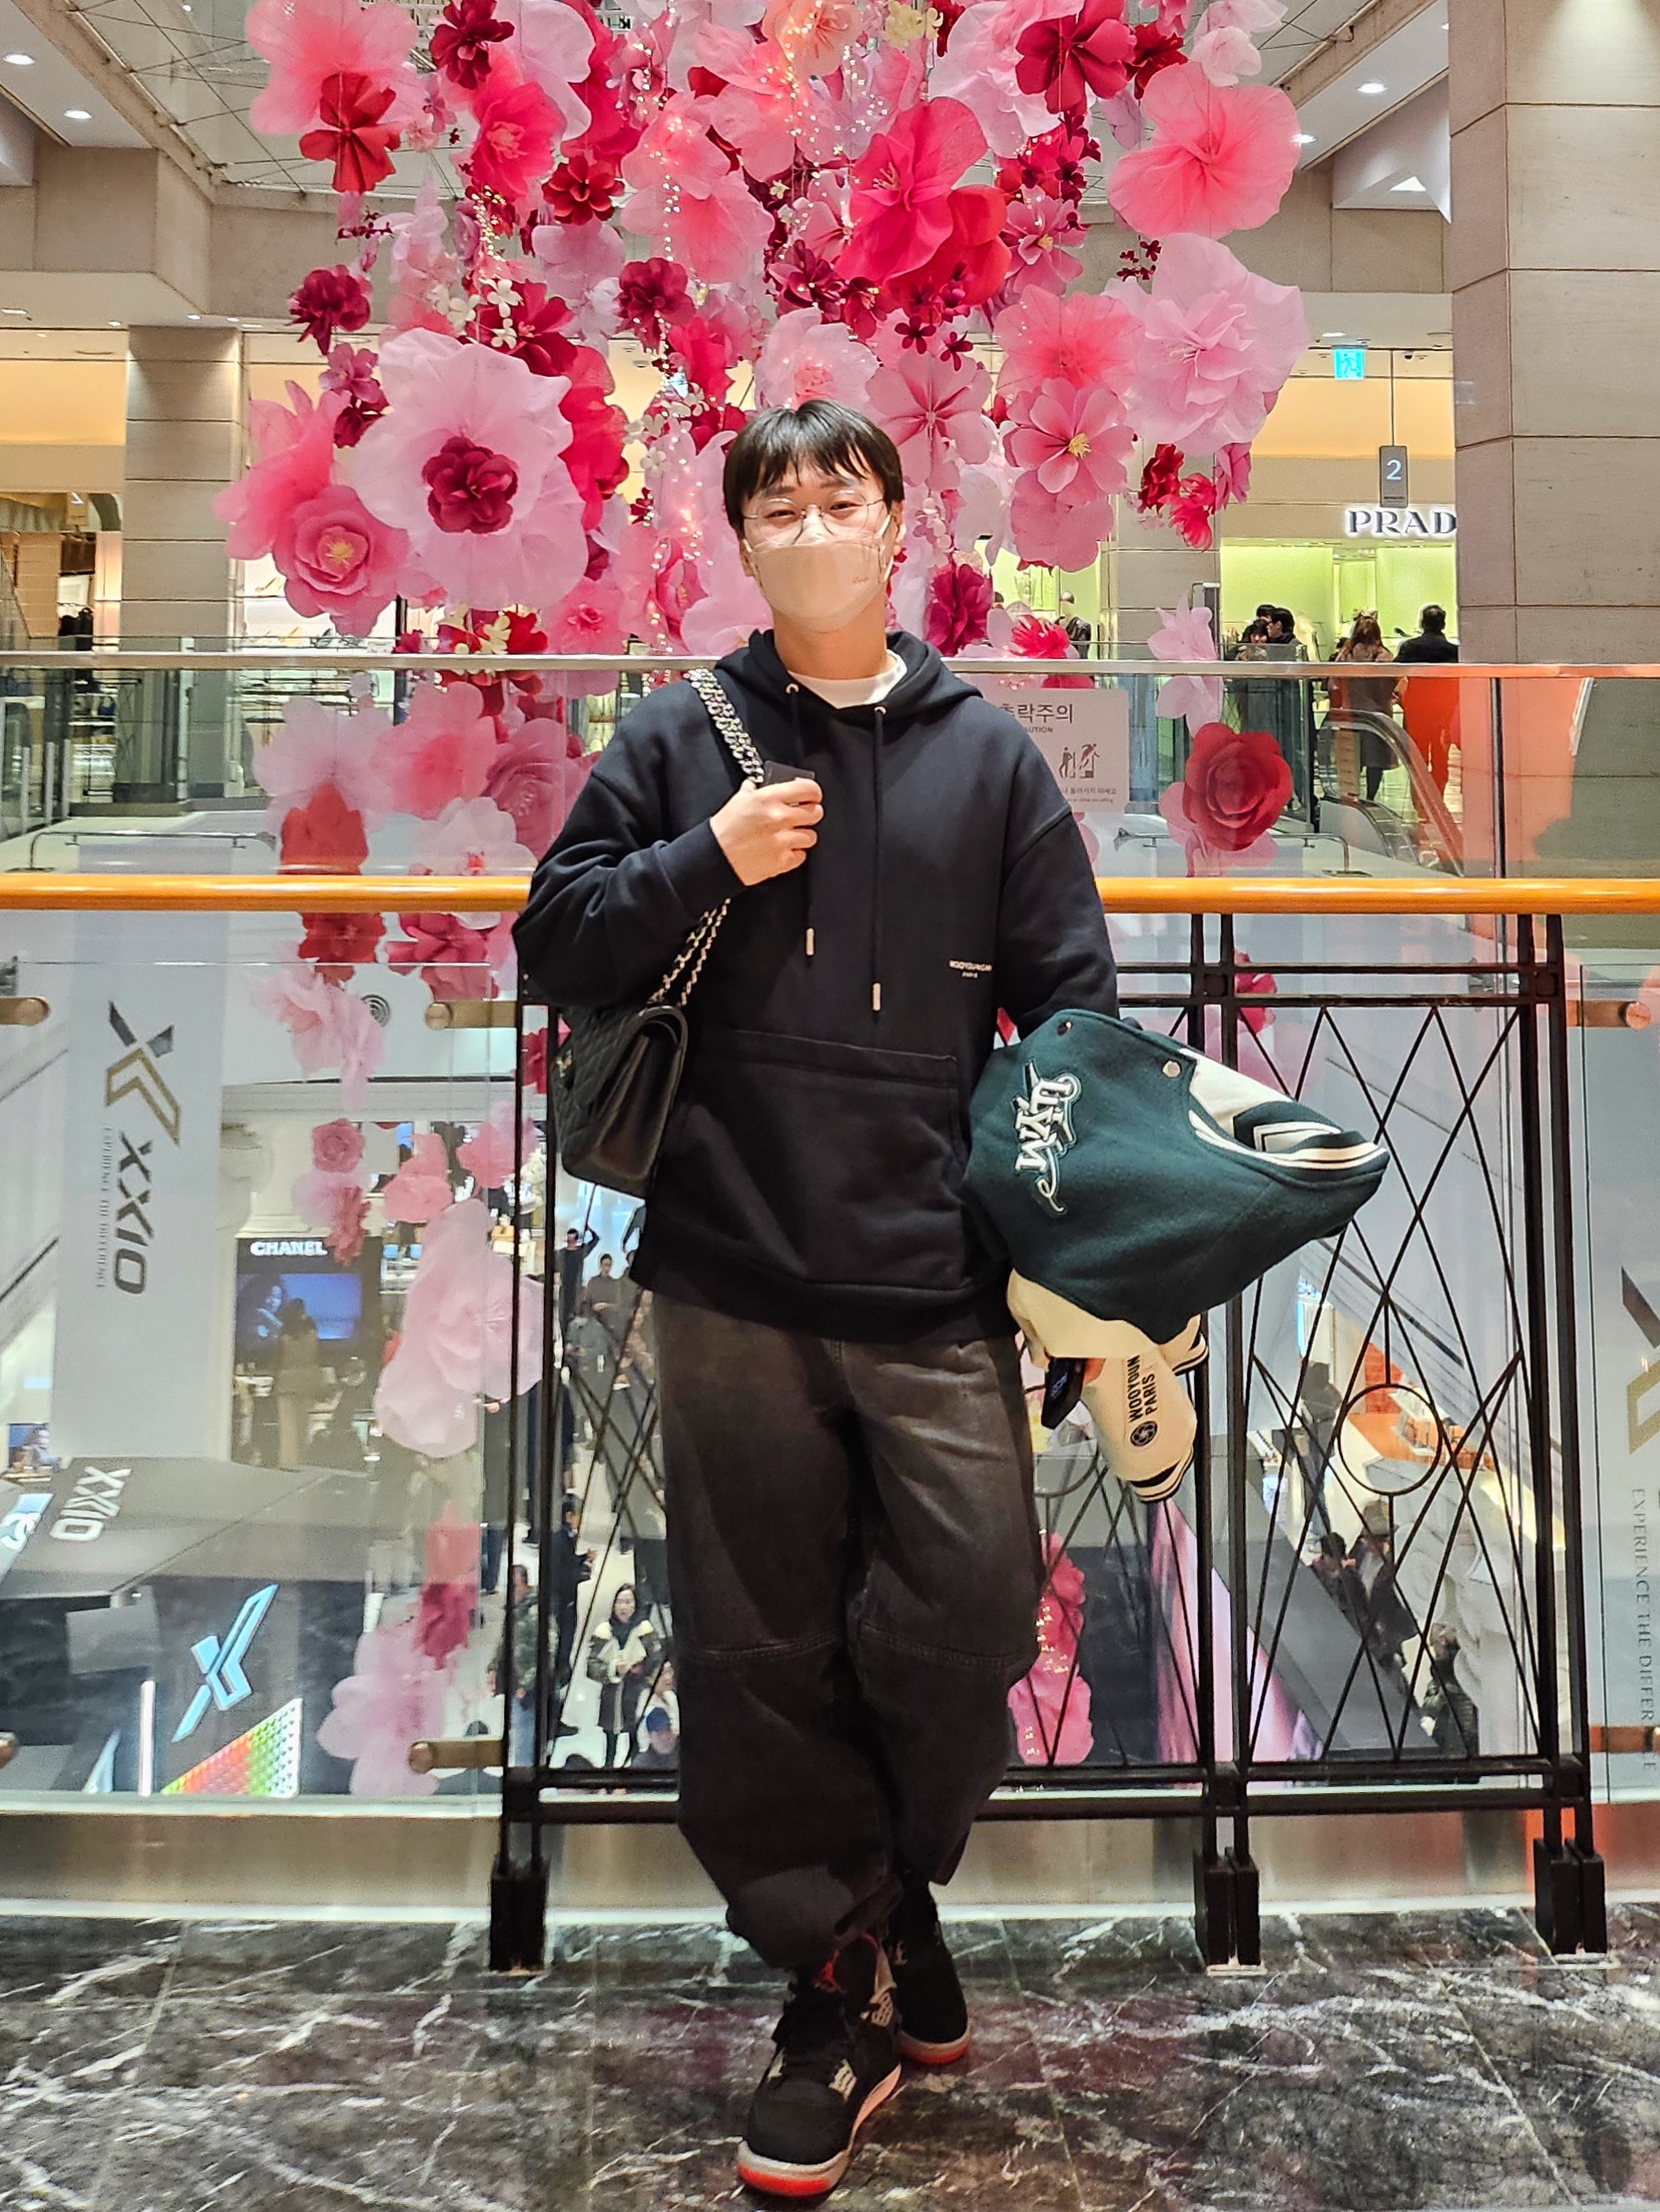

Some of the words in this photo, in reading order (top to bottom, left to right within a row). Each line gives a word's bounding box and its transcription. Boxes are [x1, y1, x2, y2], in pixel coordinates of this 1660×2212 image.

[1385, 458, 1402, 481] 2
[113, 1130, 154, 1294] XXIO
[250, 1240, 328, 1256] CHANEL
[1127, 1355, 1144, 1423] WOOYOUN
[1141, 1373, 1158, 1416] PARIS
[49, 1466, 132, 1541] XXIO
[1632, 1489, 1650, 1604] EXPERIENCE
[1637, 1614, 1652, 1648] THE
[1639, 1655, 1657, 1771] DIFFERE
